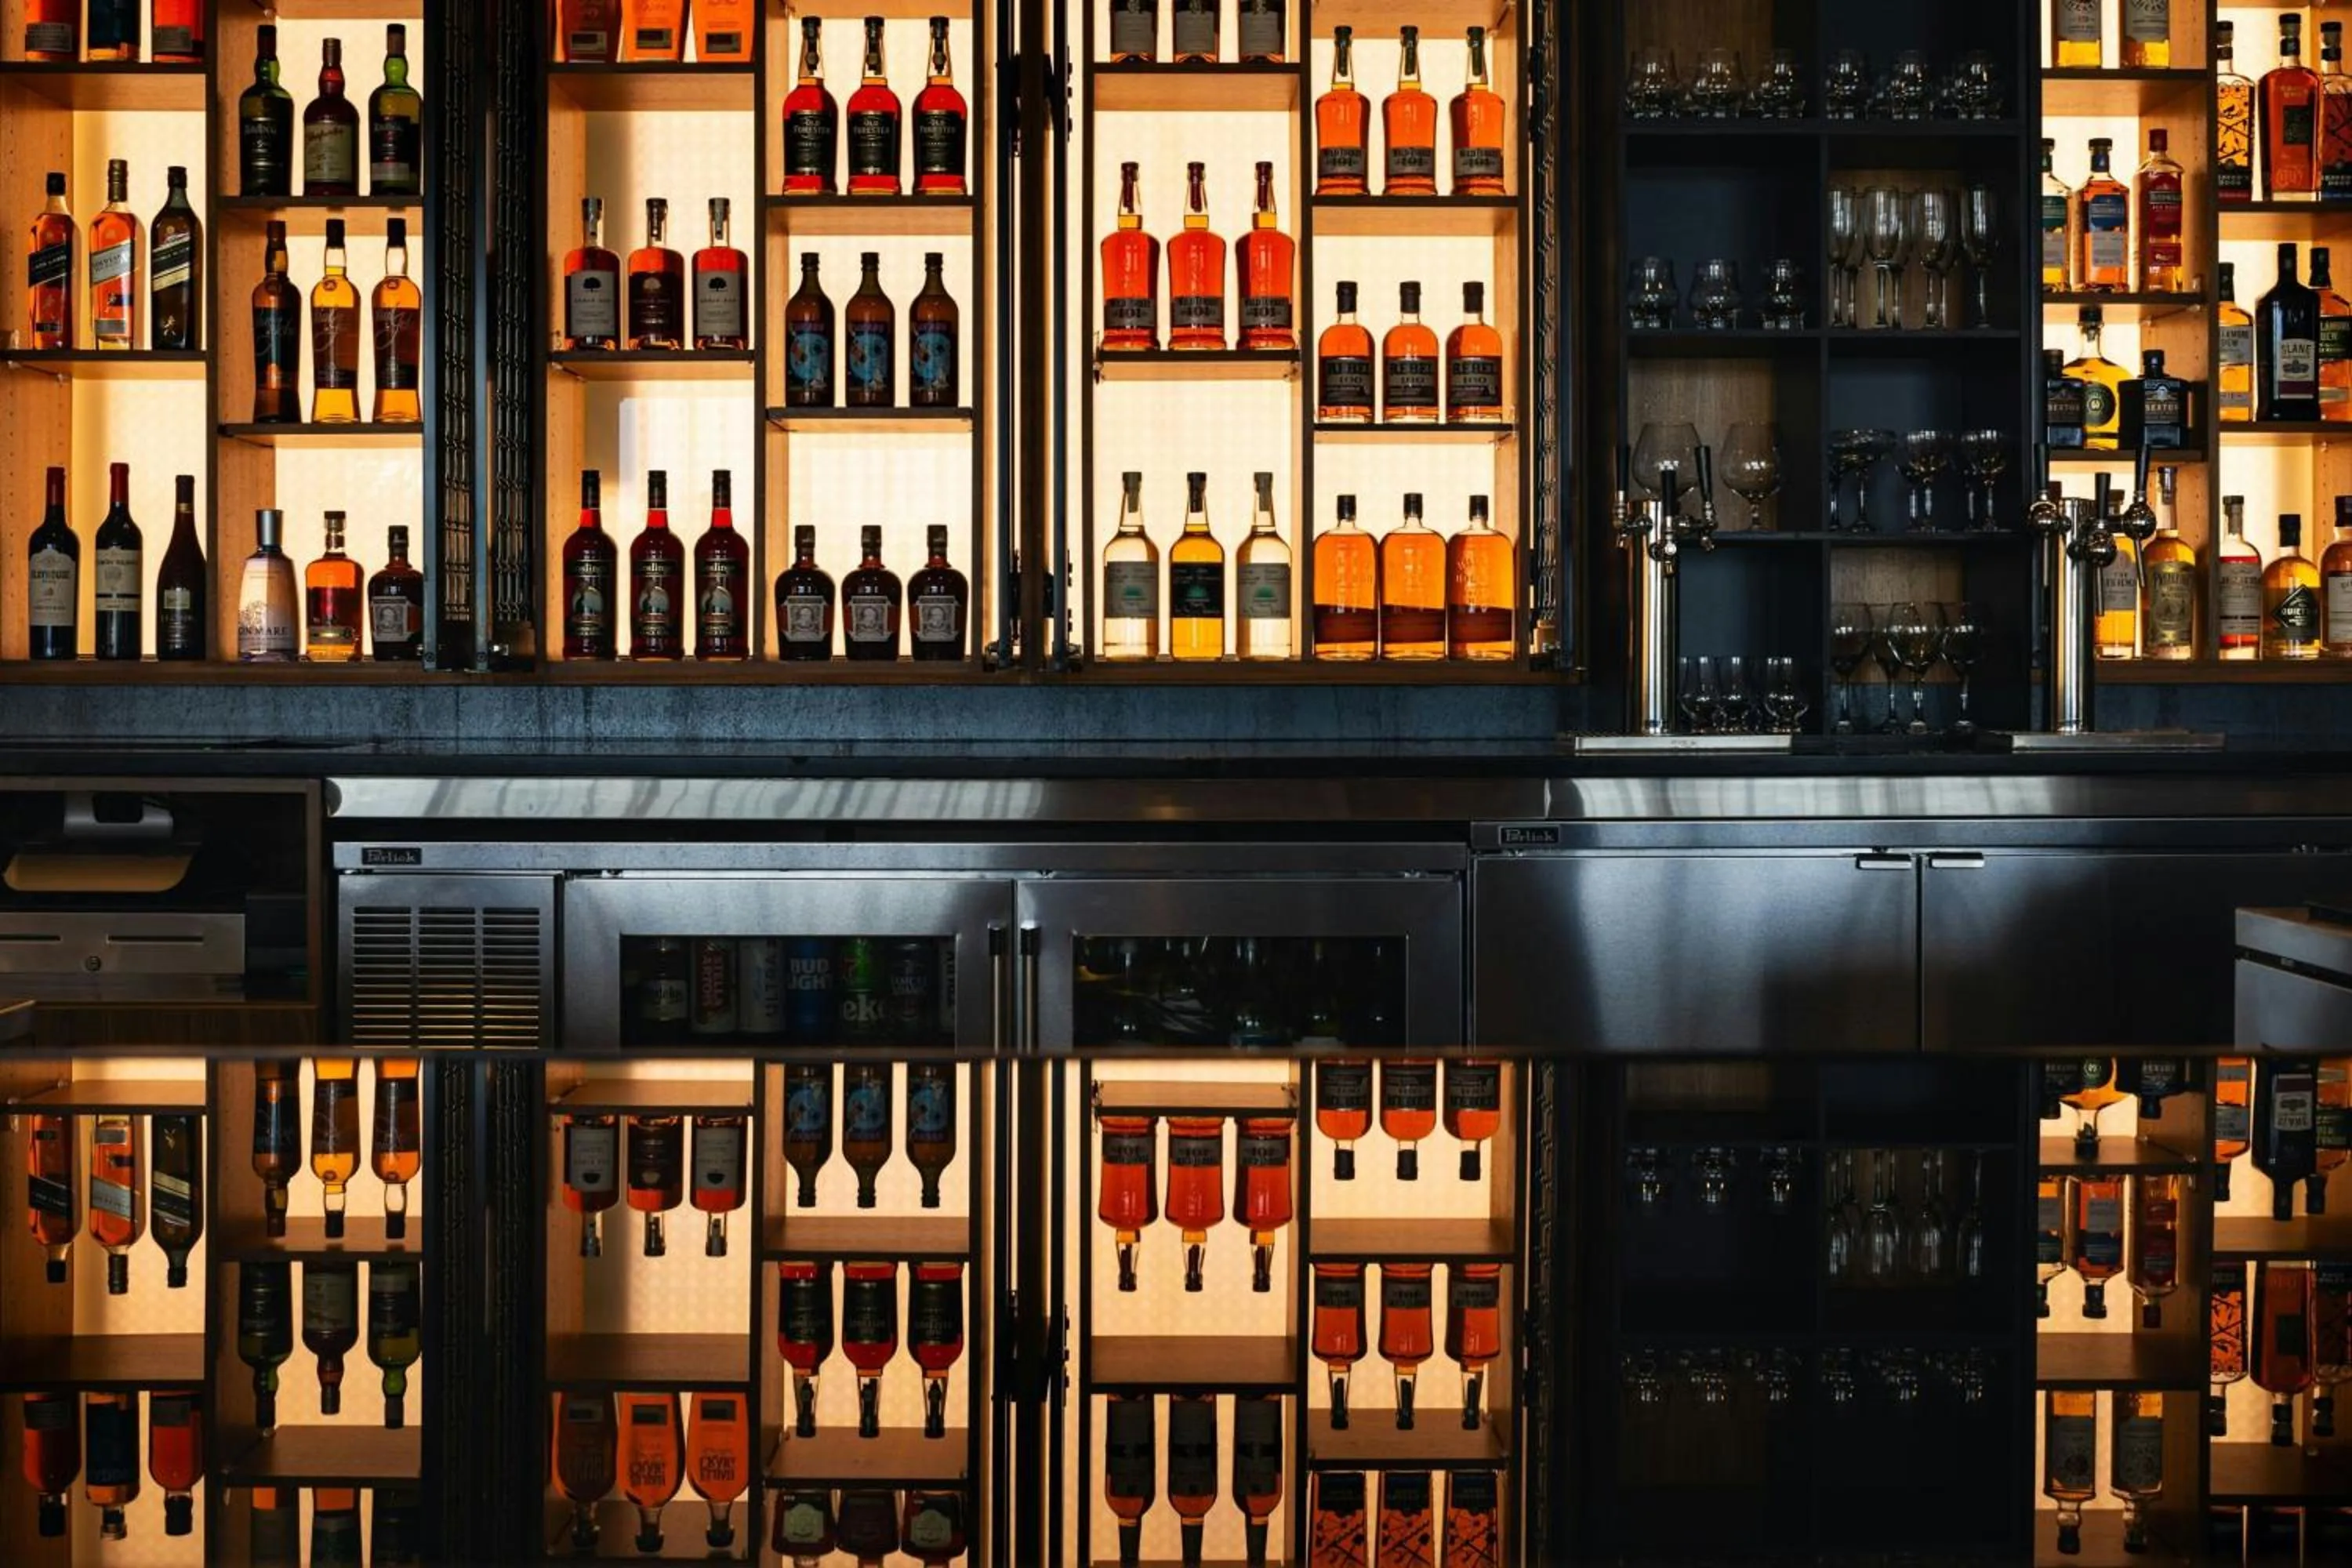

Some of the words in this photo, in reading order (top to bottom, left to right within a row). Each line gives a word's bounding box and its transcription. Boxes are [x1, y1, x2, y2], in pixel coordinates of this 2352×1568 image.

[2281, 344, 2311, 353] SLANE
[789, 957, 829, 974] BUD
[765, 954, 779, 1017] ULTRA
